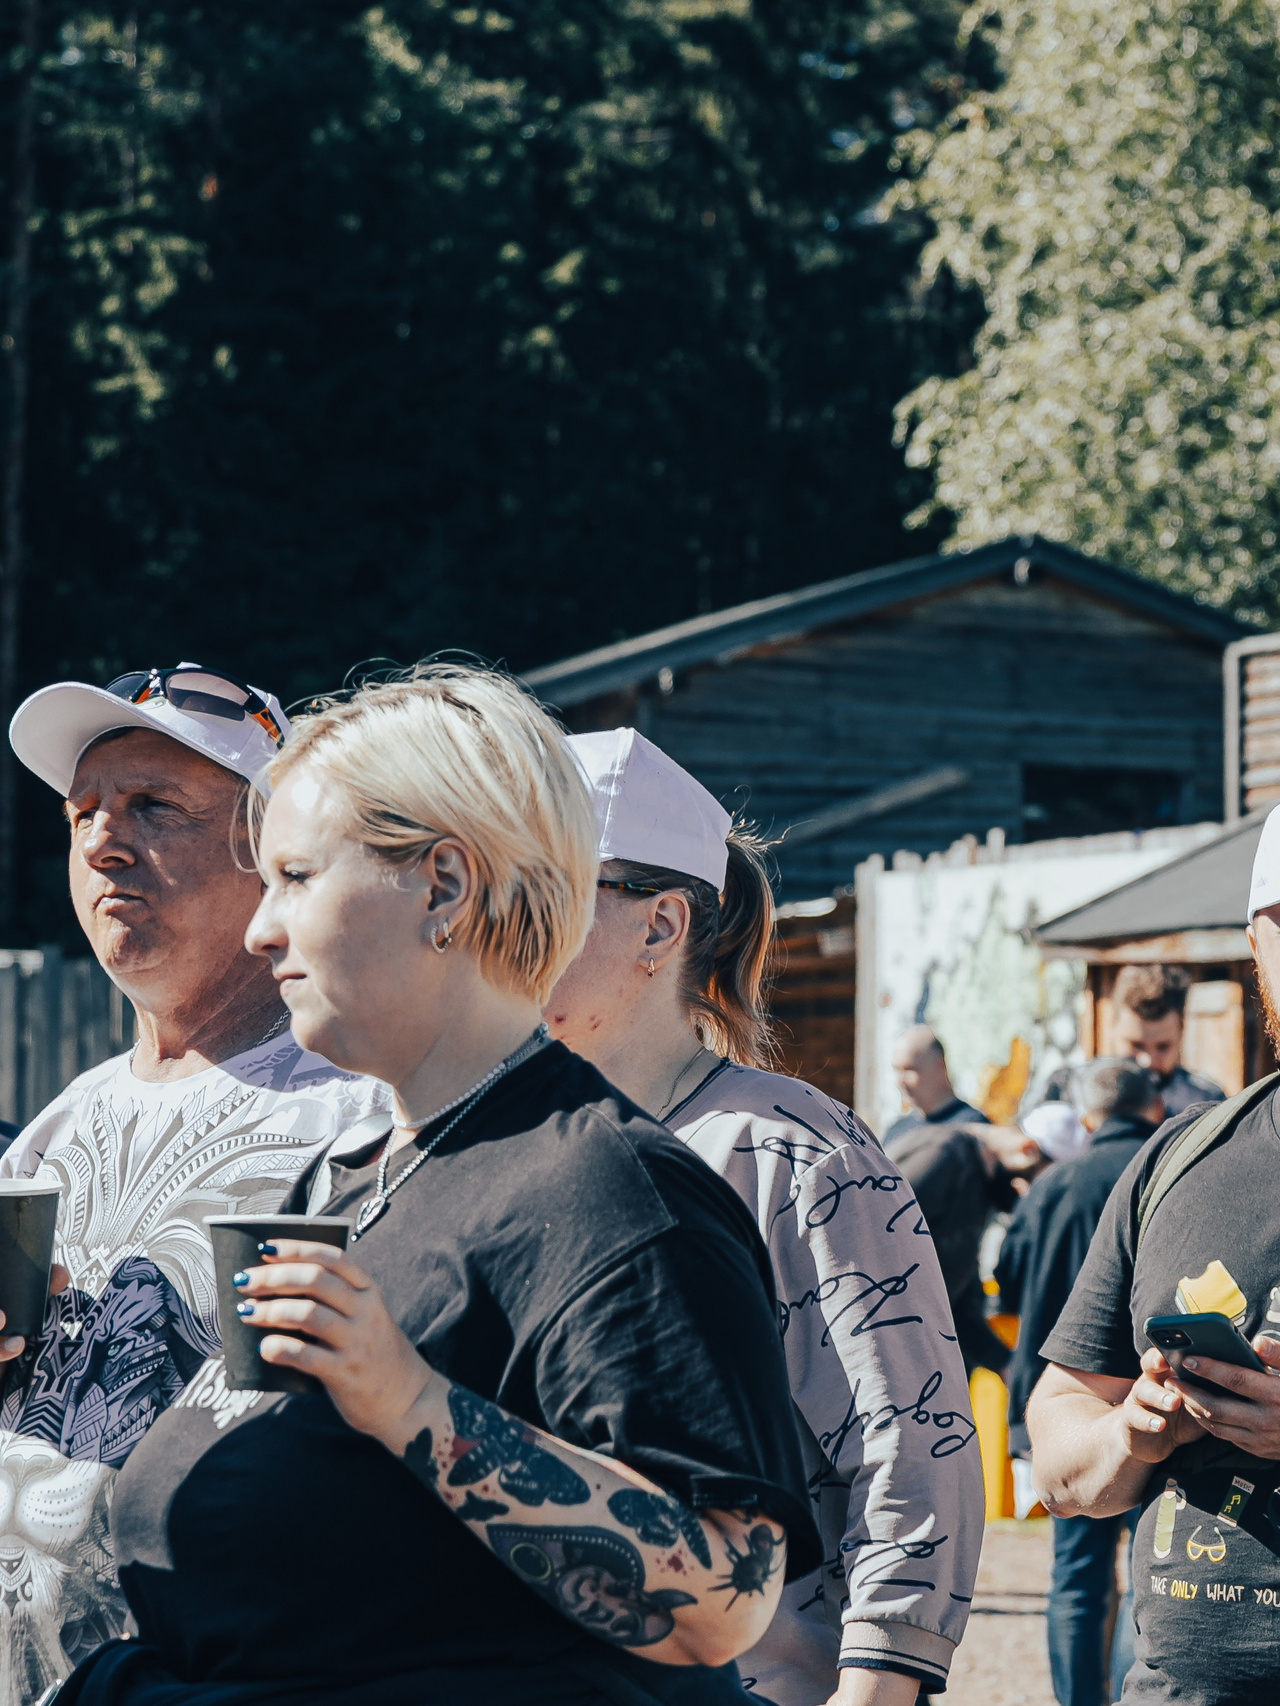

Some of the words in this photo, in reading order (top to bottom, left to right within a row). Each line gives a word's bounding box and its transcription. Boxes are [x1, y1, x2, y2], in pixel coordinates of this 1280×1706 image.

[1234, 1479, 1252, 1492] MUSIC
[1150, 1575, 1167, 1595] TAKE
[1170, 1579, 1198, 1600] ONLY
[1206, 1583, 1244, 1602] WHAT
